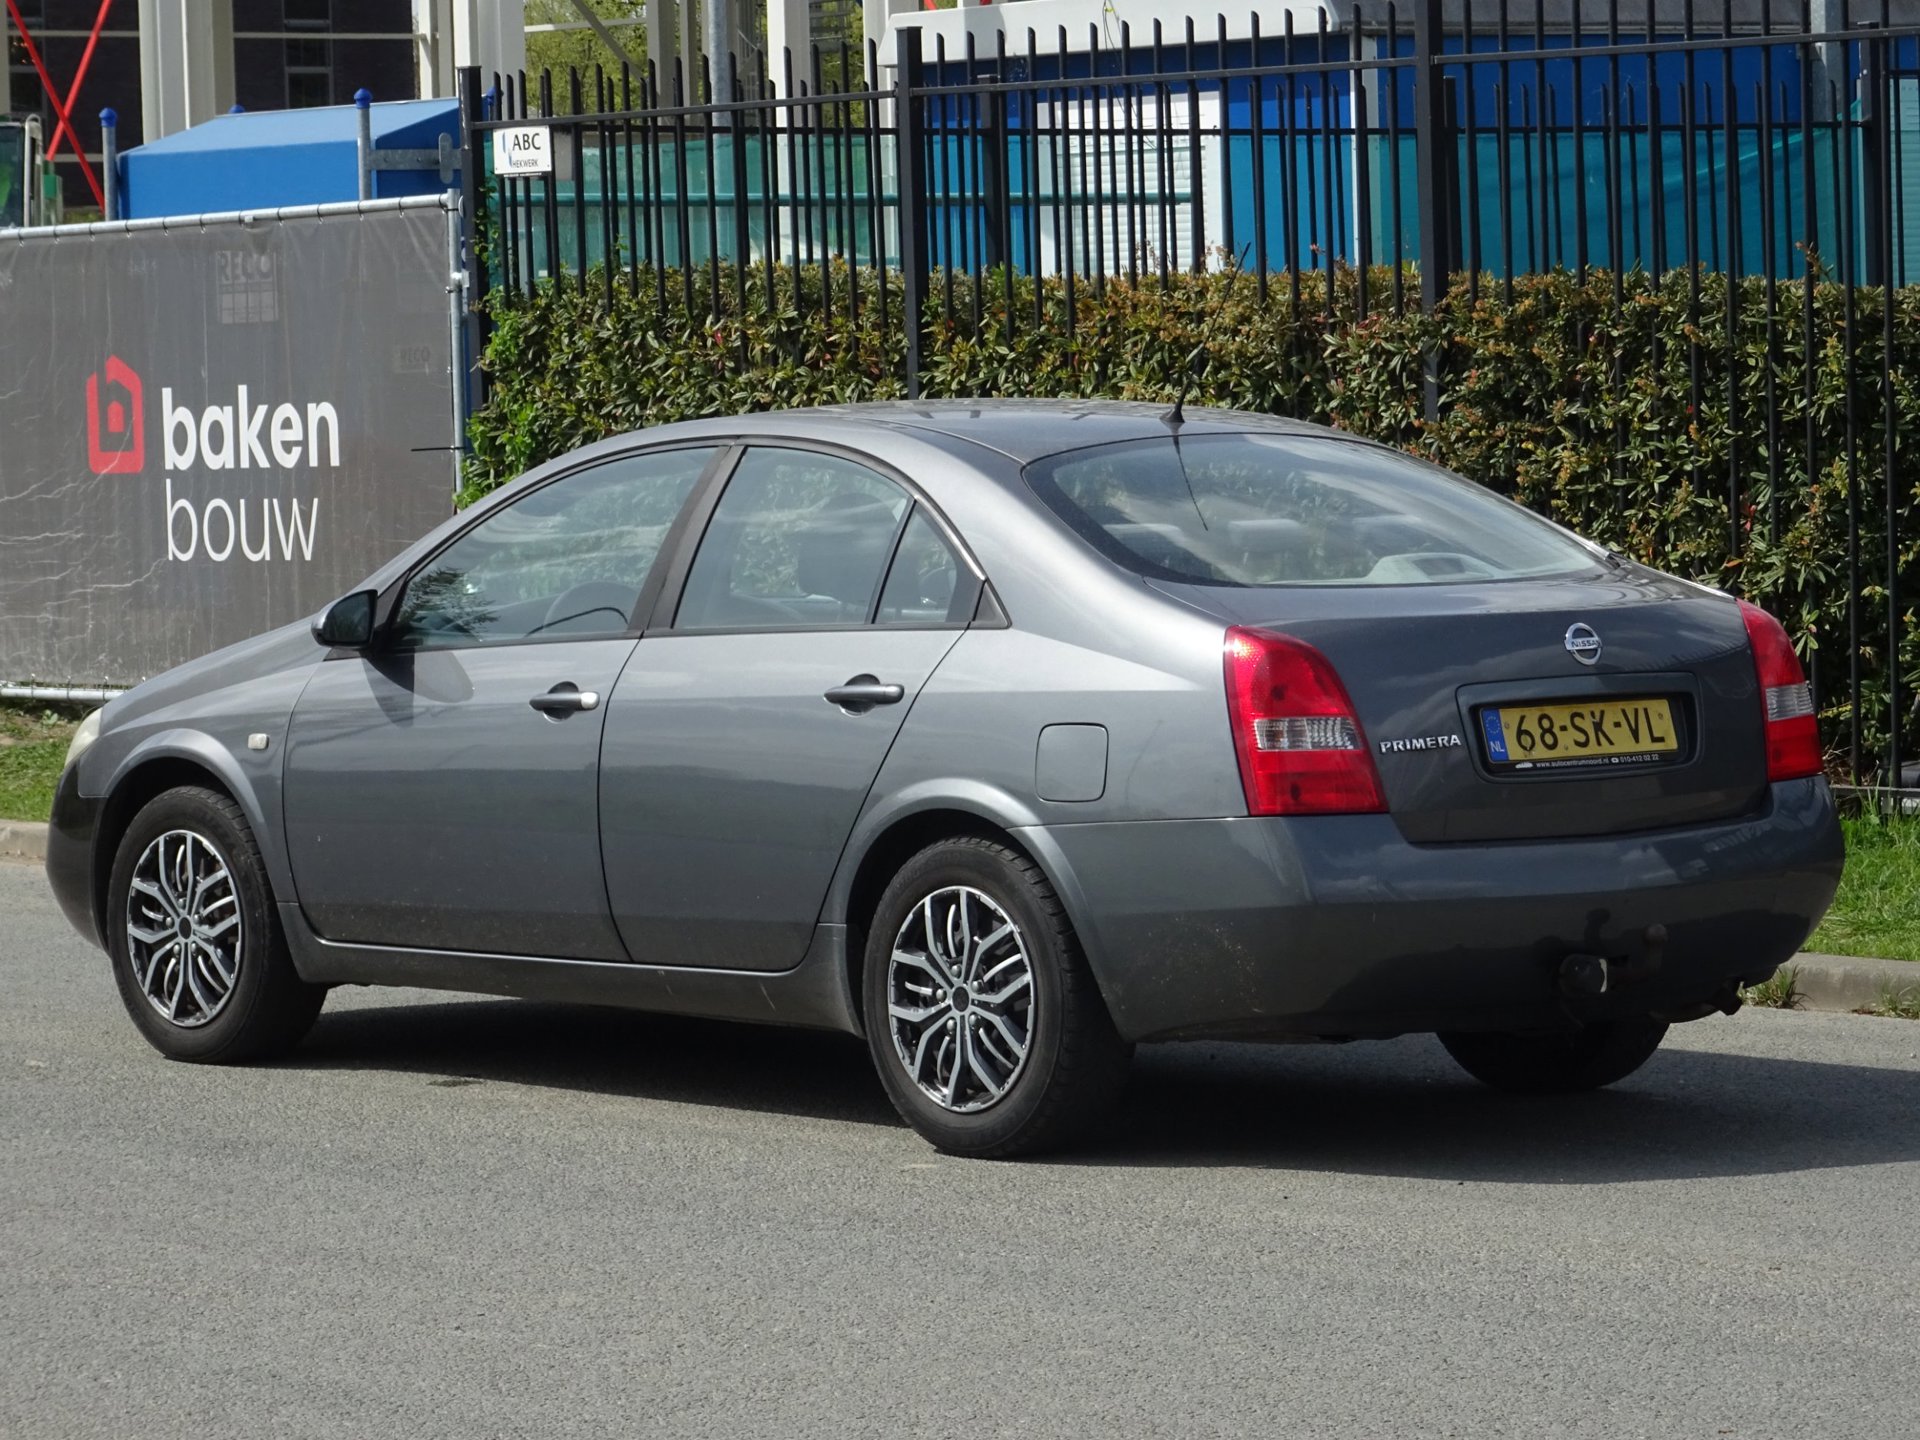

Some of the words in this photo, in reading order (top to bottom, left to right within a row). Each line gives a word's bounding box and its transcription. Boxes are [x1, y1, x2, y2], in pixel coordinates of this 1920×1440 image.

[512, 133, 541, 151] ABC
[162, 384, 340, 471] baken
[165, 478, 319, 562] bouw
[1380, 734, 1462, 753] PRIMERA
[1515, 707, 1666, 751] 68-SK-VL
[1490, 741, 1505, 753] NL
